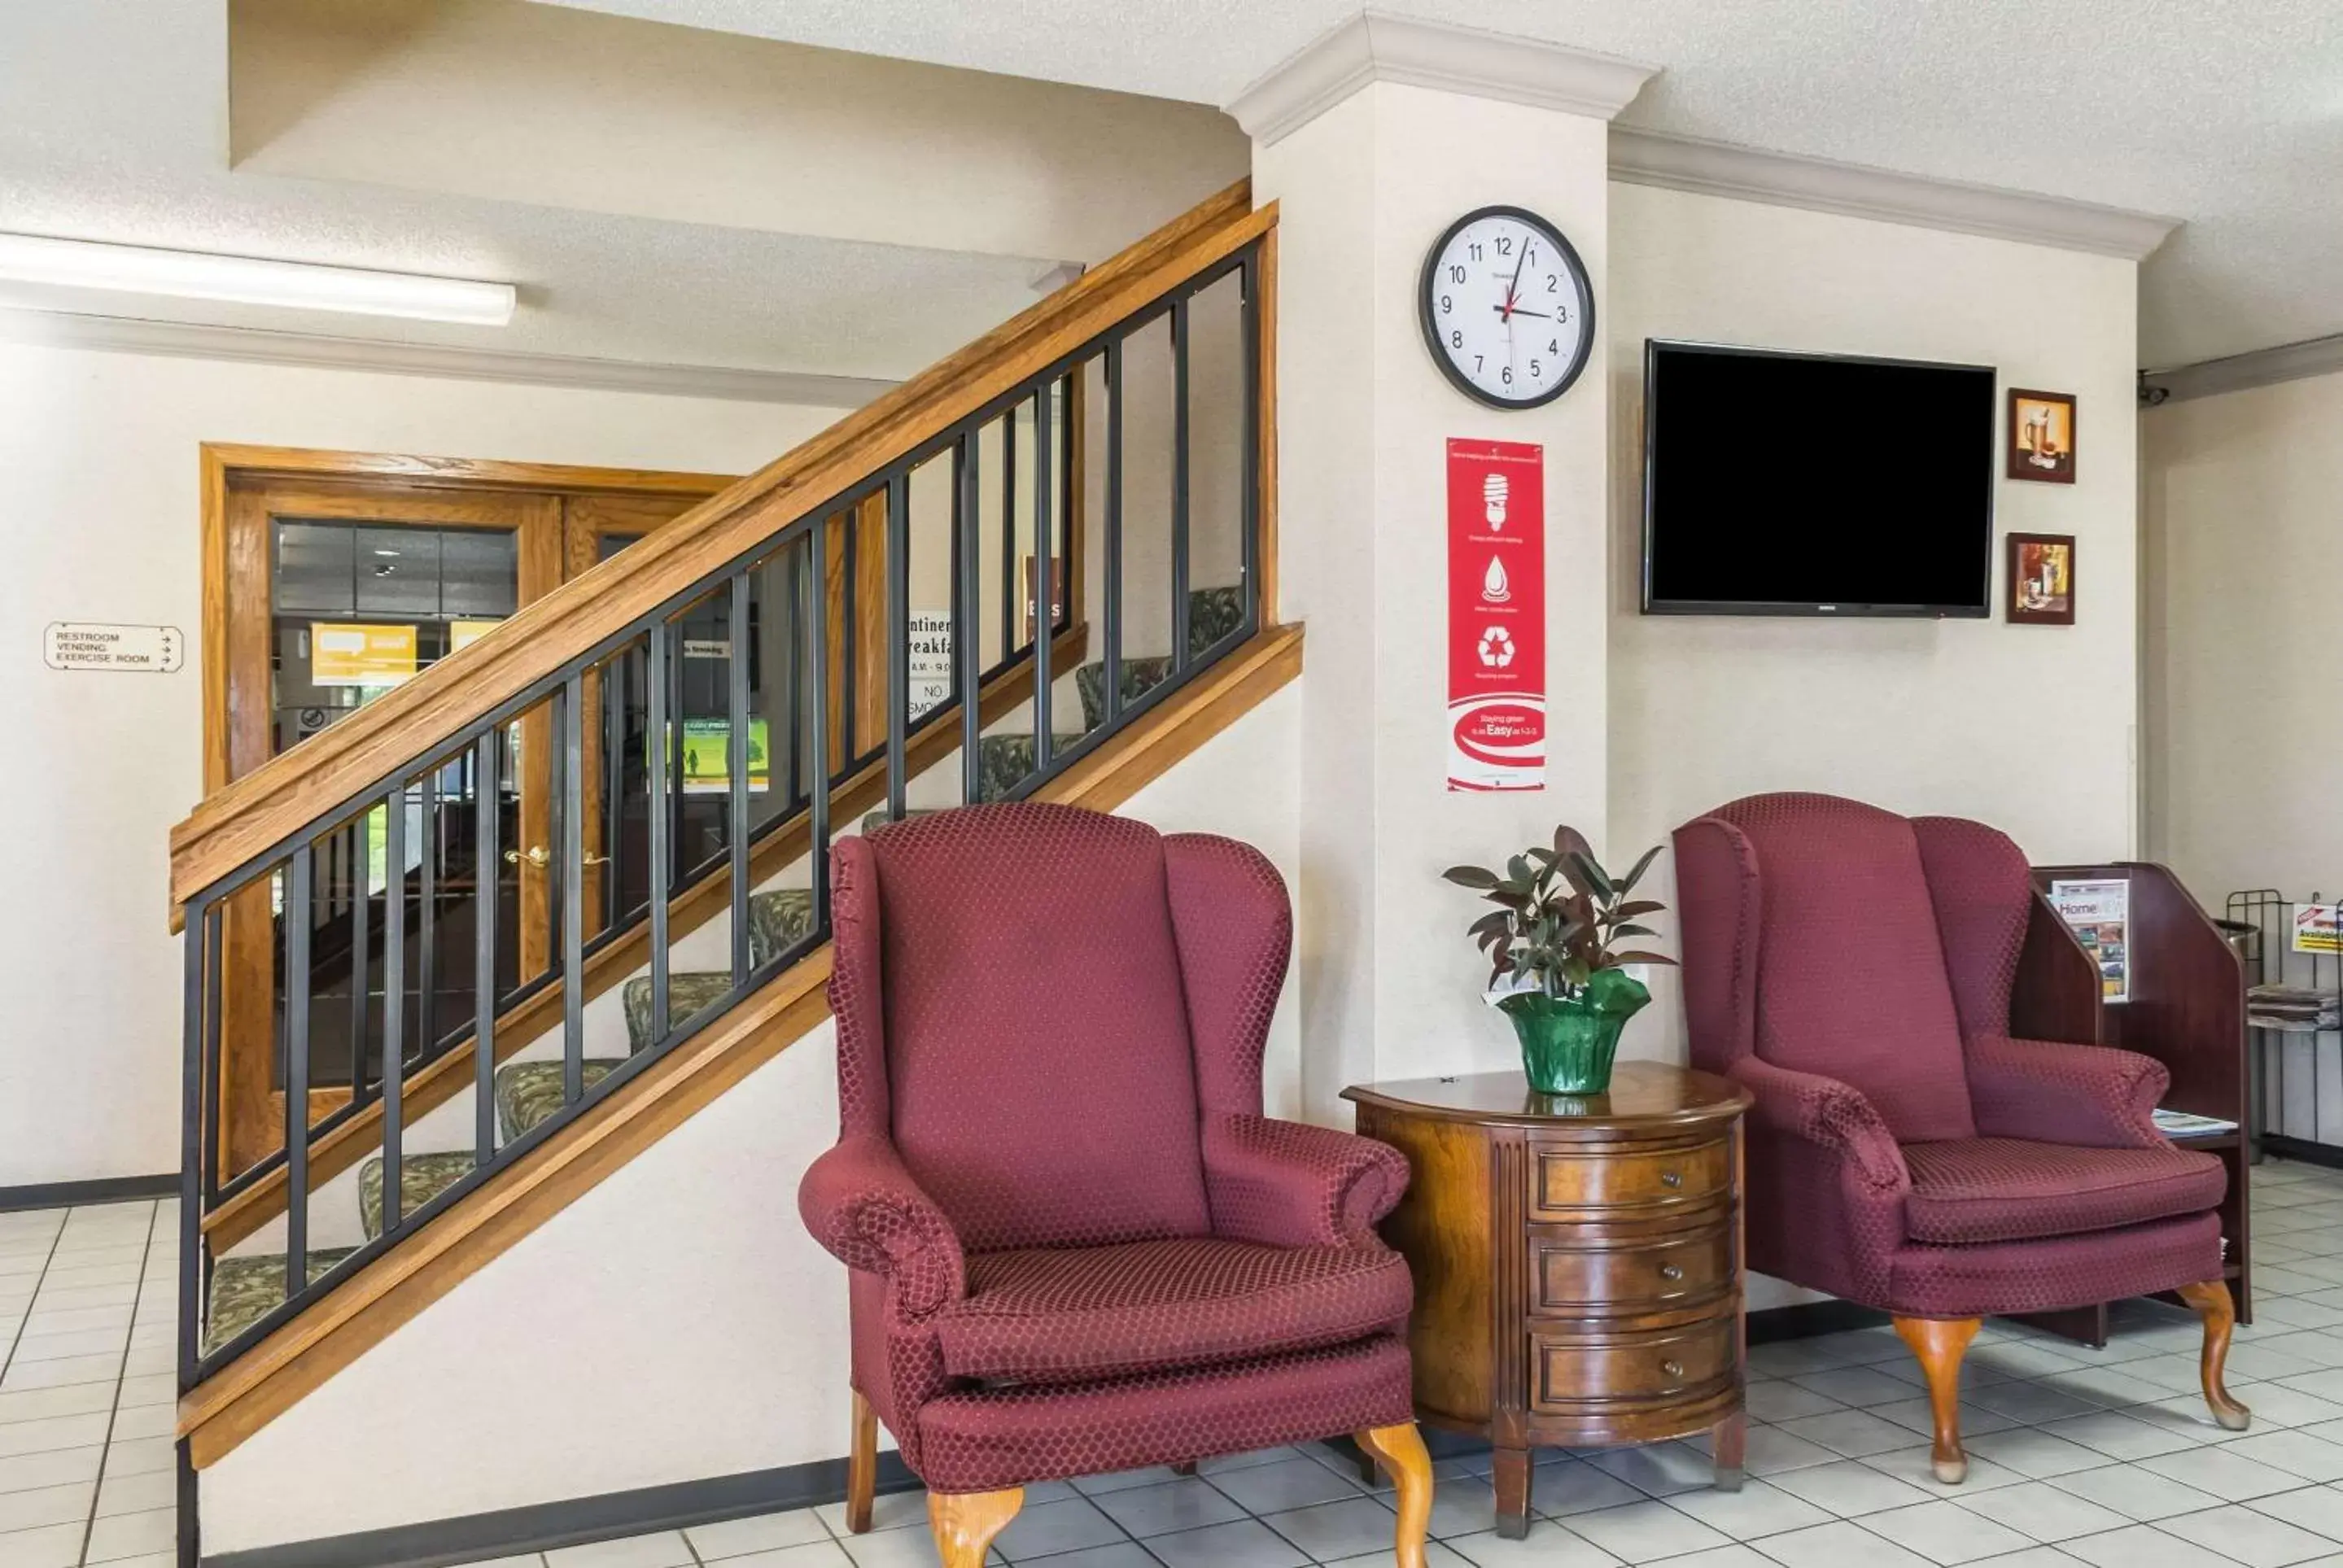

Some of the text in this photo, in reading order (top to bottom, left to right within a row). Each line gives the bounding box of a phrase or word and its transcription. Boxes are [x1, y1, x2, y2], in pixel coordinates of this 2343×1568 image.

[1469, 243, 1482, 261] 11
[1495, 238, 1511, 256] 12
[1529, 250, 1535, 268] 1
[1449, 265, 1466, 284] 10
[1547, 274, 1558, 292] 2
[1441, 295, 1452, 314] 9
[1556, 306, 1567, 324] 3
[1452, 330, 1463, 349] 8
[1549, 338, 1558, 356] 4
[1475, 356, 1484, 373] 7
[1530, 360, 1541, 377] 5
[1502, 366, 1512, 385] 6
[910, 617, 951, 632] ntine
[55, 631, 120, 642] RESTROOM
[909, 637, 951, 653] eakf
[56, 643, 107, 653] VENDING
[55, 653, 150, 663] EXERCISE ROOM
[924, 685, 942, 697] NO
[909, 702, 934, 714] SMO
[1486, 723, 1513, 738] Easy
[2060, 903, 2097, 915] Home
